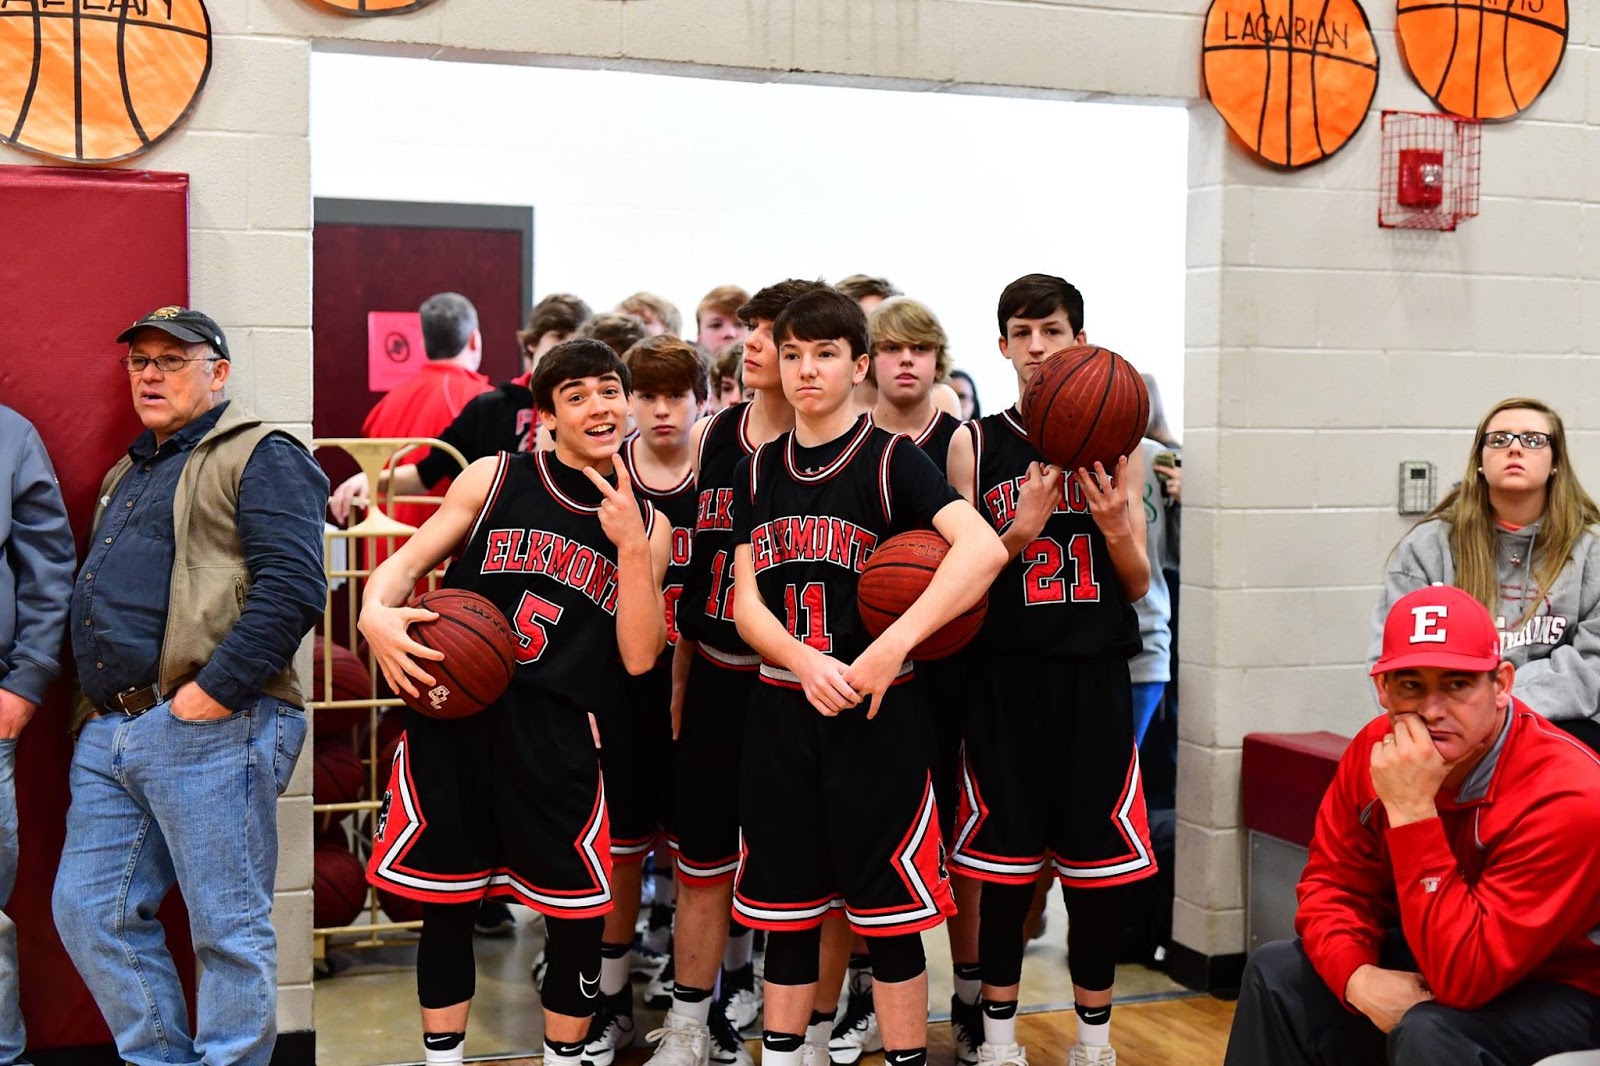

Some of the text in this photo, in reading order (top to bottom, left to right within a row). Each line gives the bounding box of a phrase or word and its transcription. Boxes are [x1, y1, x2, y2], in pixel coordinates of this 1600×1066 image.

[1225, 11, 1348, 49] LAGARIAN
[750, 515, 878, 575] ELKMONT
[1022, 533, 1100, 606] 21
[513, 589, 564, 664] 5
[784, 582, 833, 653] 11
[1409, 605, 1448, 643] E
